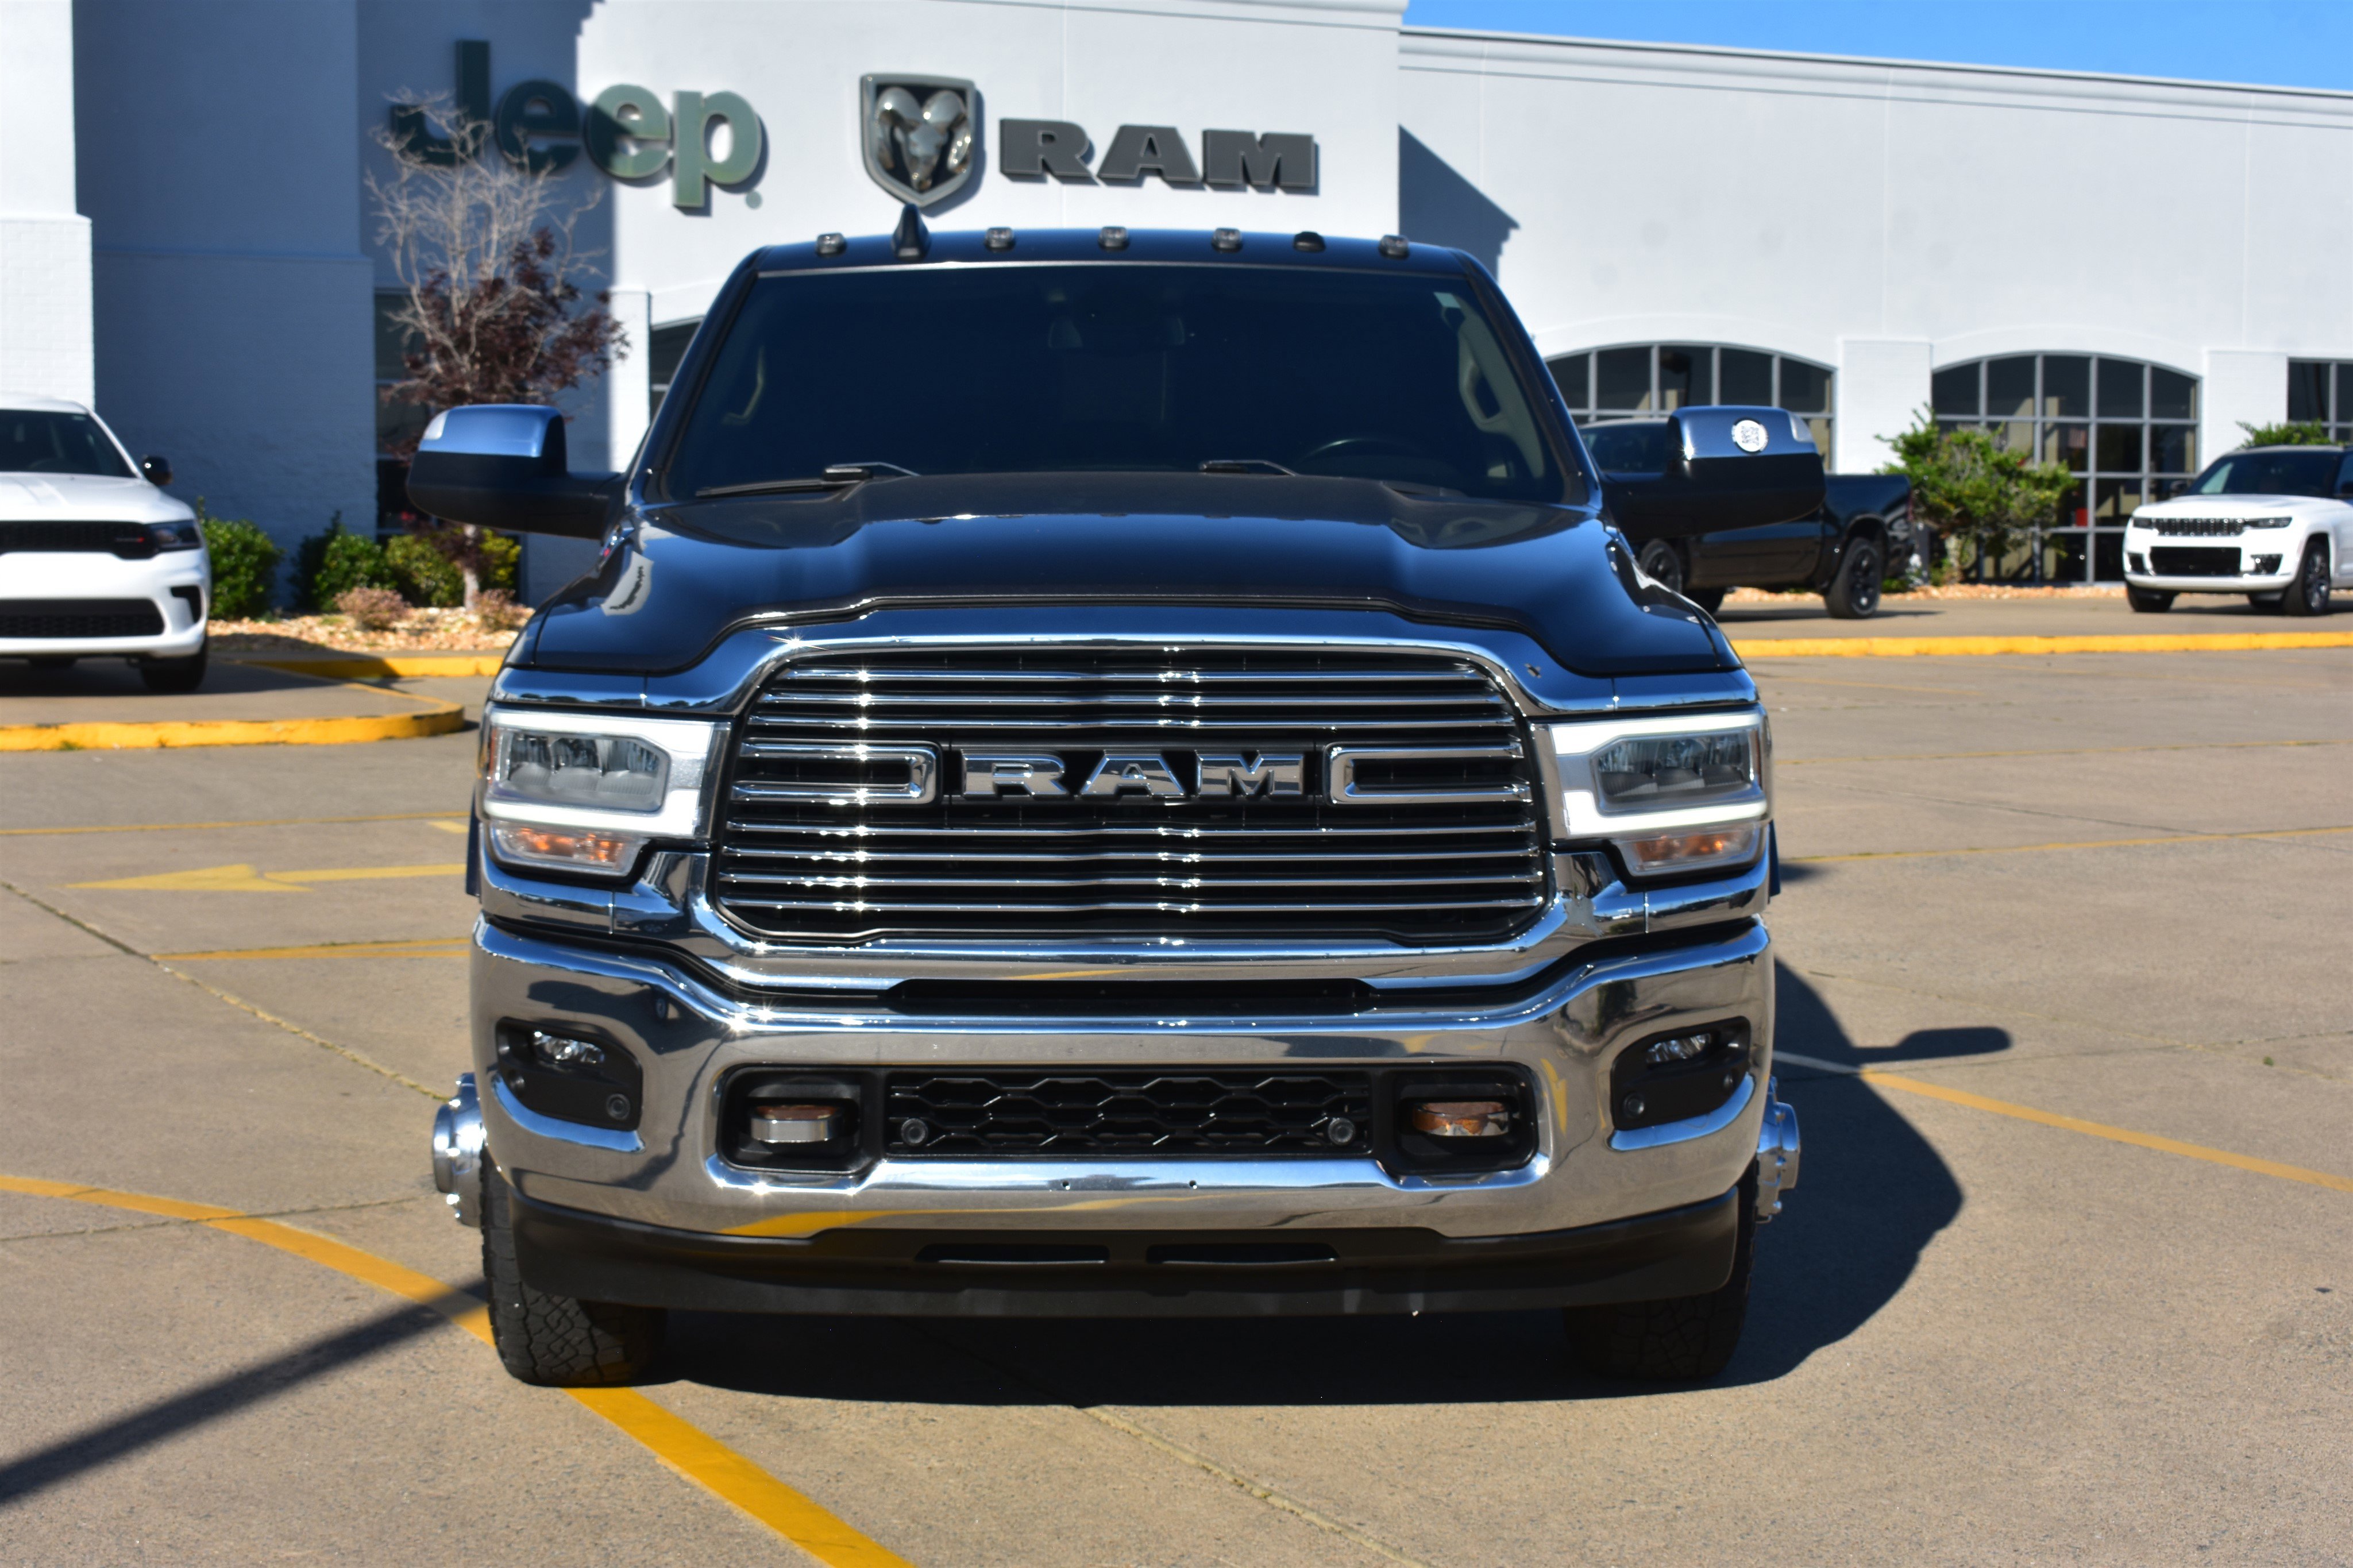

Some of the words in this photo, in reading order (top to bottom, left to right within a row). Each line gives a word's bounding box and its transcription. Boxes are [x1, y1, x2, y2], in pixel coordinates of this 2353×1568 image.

[389, 40, 762, 207] Jeep
[1000, 118, 1314, 187] RAM
[961, 750, 1305, 797] RAM
